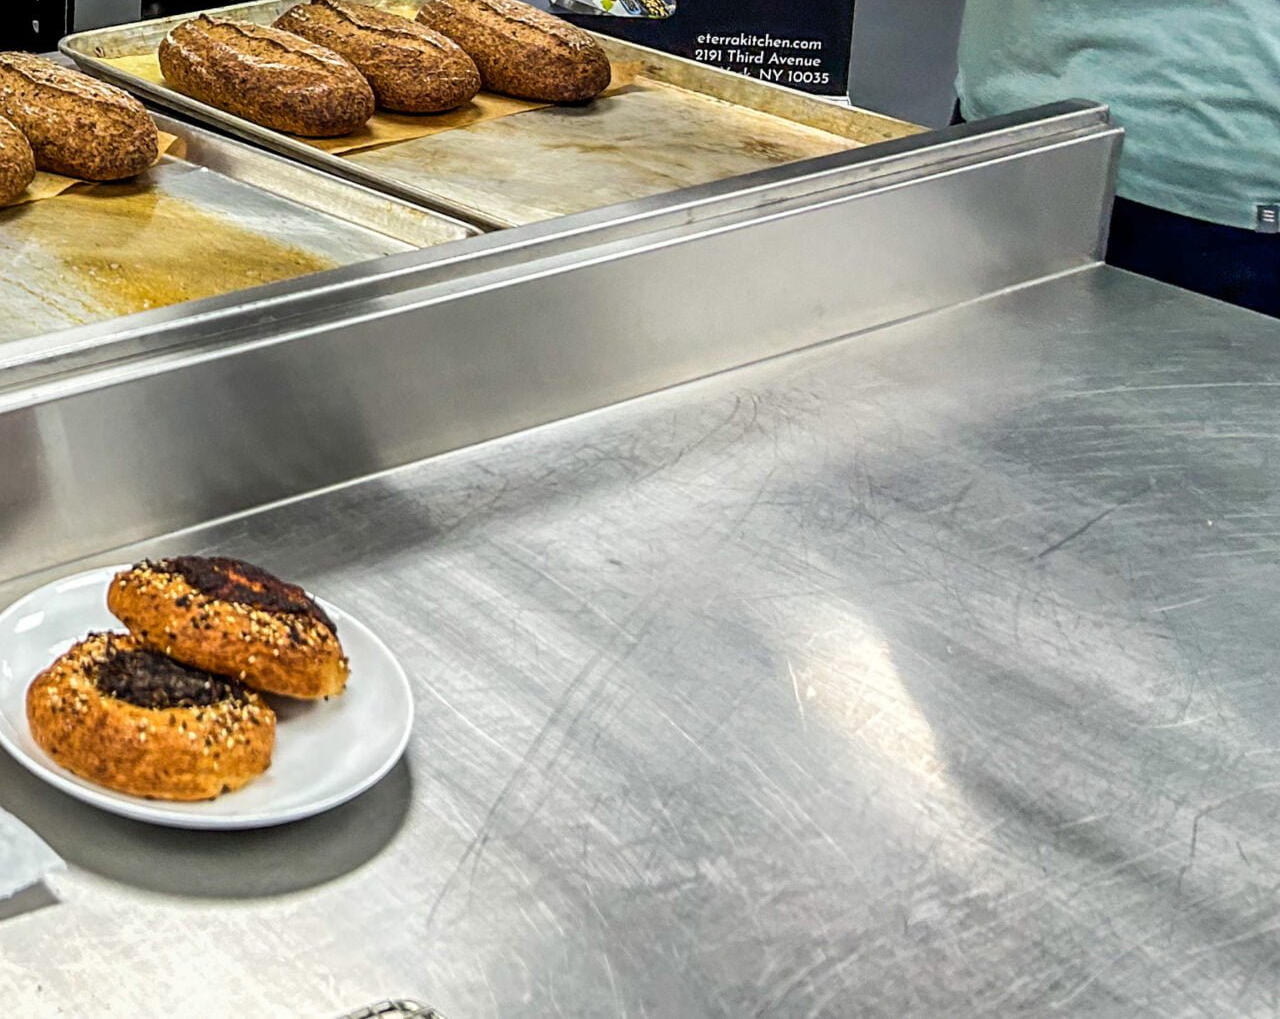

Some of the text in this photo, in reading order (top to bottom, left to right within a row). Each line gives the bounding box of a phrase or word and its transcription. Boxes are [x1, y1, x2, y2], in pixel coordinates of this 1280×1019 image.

[697, 33, 822, 50] eterrakitchen.com
[695, 49, 821, 67] 2191 Third Avenue
[760, 68, 783, 81] NY
[788, 70, 829, 84] 10035
